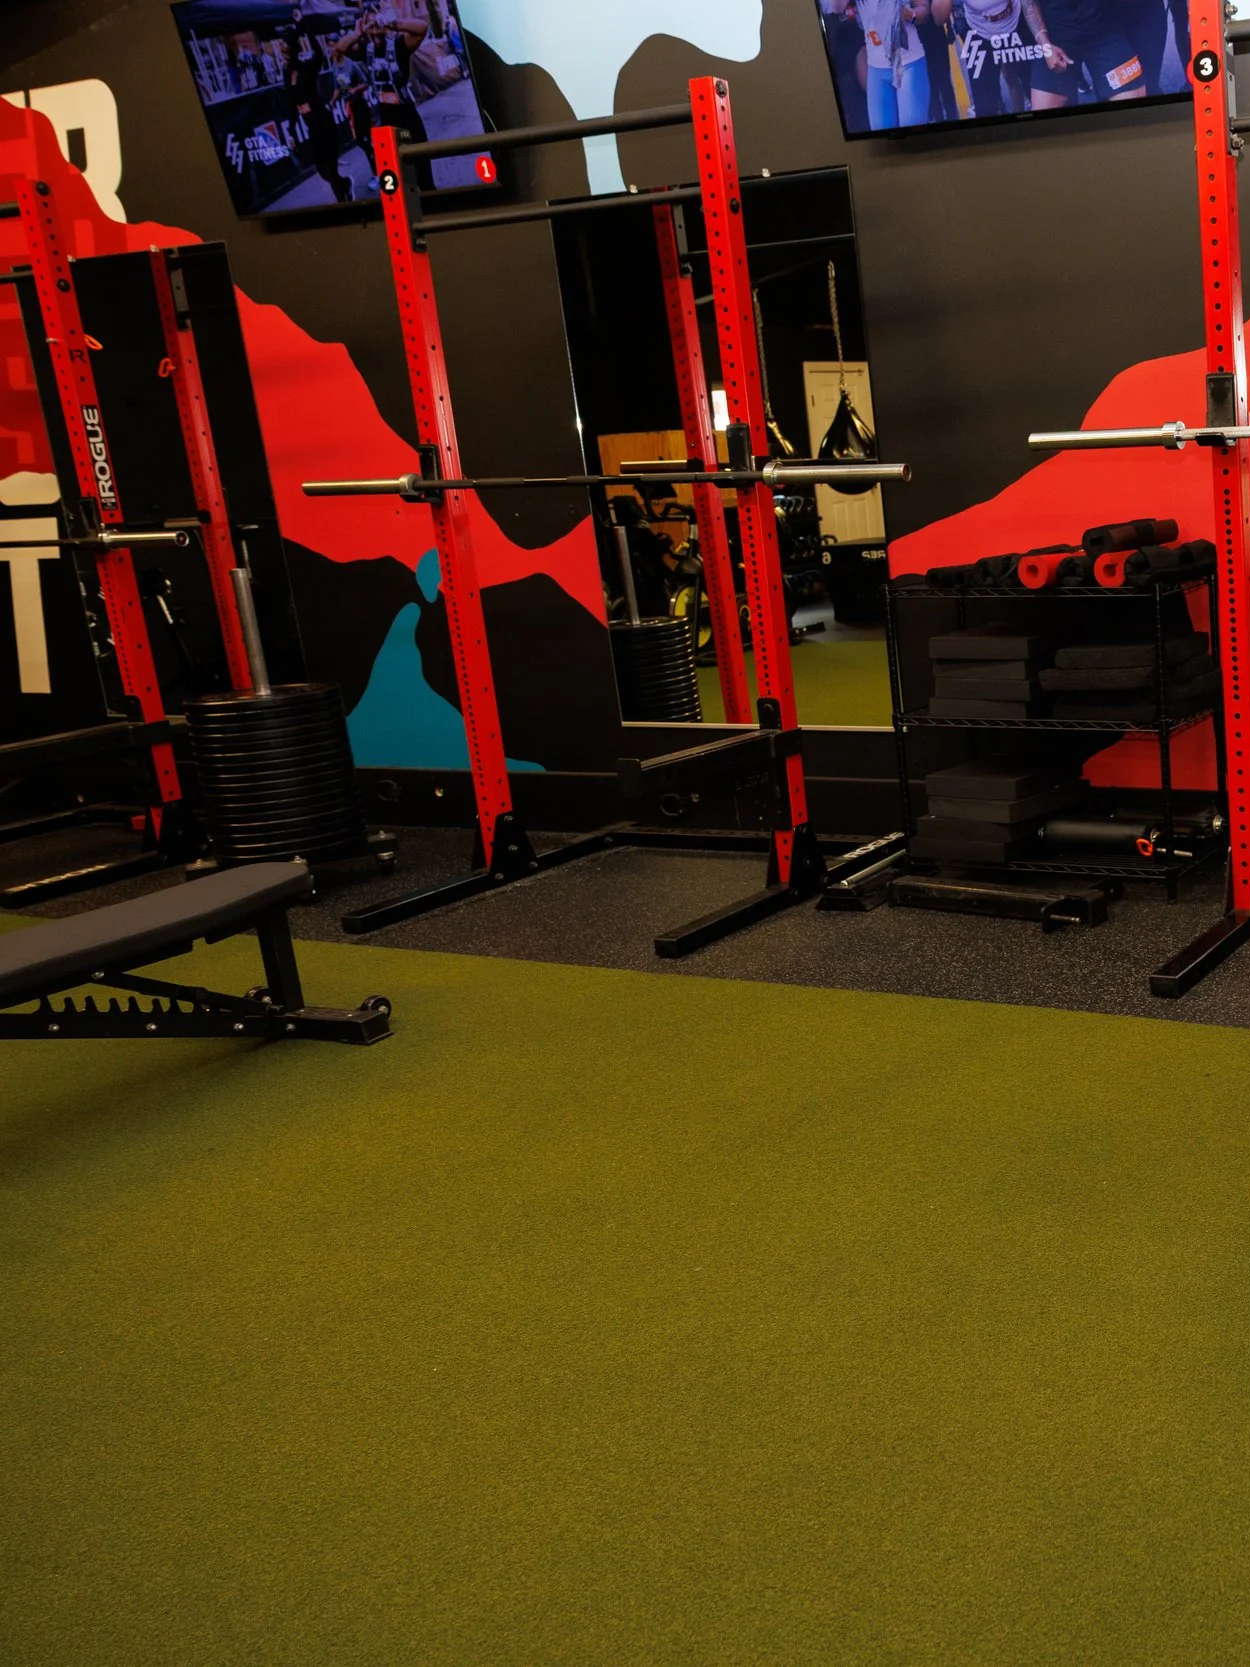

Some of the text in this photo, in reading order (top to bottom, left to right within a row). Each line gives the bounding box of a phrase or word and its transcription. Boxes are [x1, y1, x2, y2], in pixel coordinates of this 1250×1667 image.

[991, 32, 1022, 49] GTA
[993, 43, 1052, 64] FITNESS
[1200, 57, 1213, 76] 3
[244, 136, 267, 149] GTA
[248, 145, 290, 162] FITNESS
[481, 160, 491, 178] 1
[384, 175, 395, 190] 2
[83, 406, 116, 503] ROGUE
